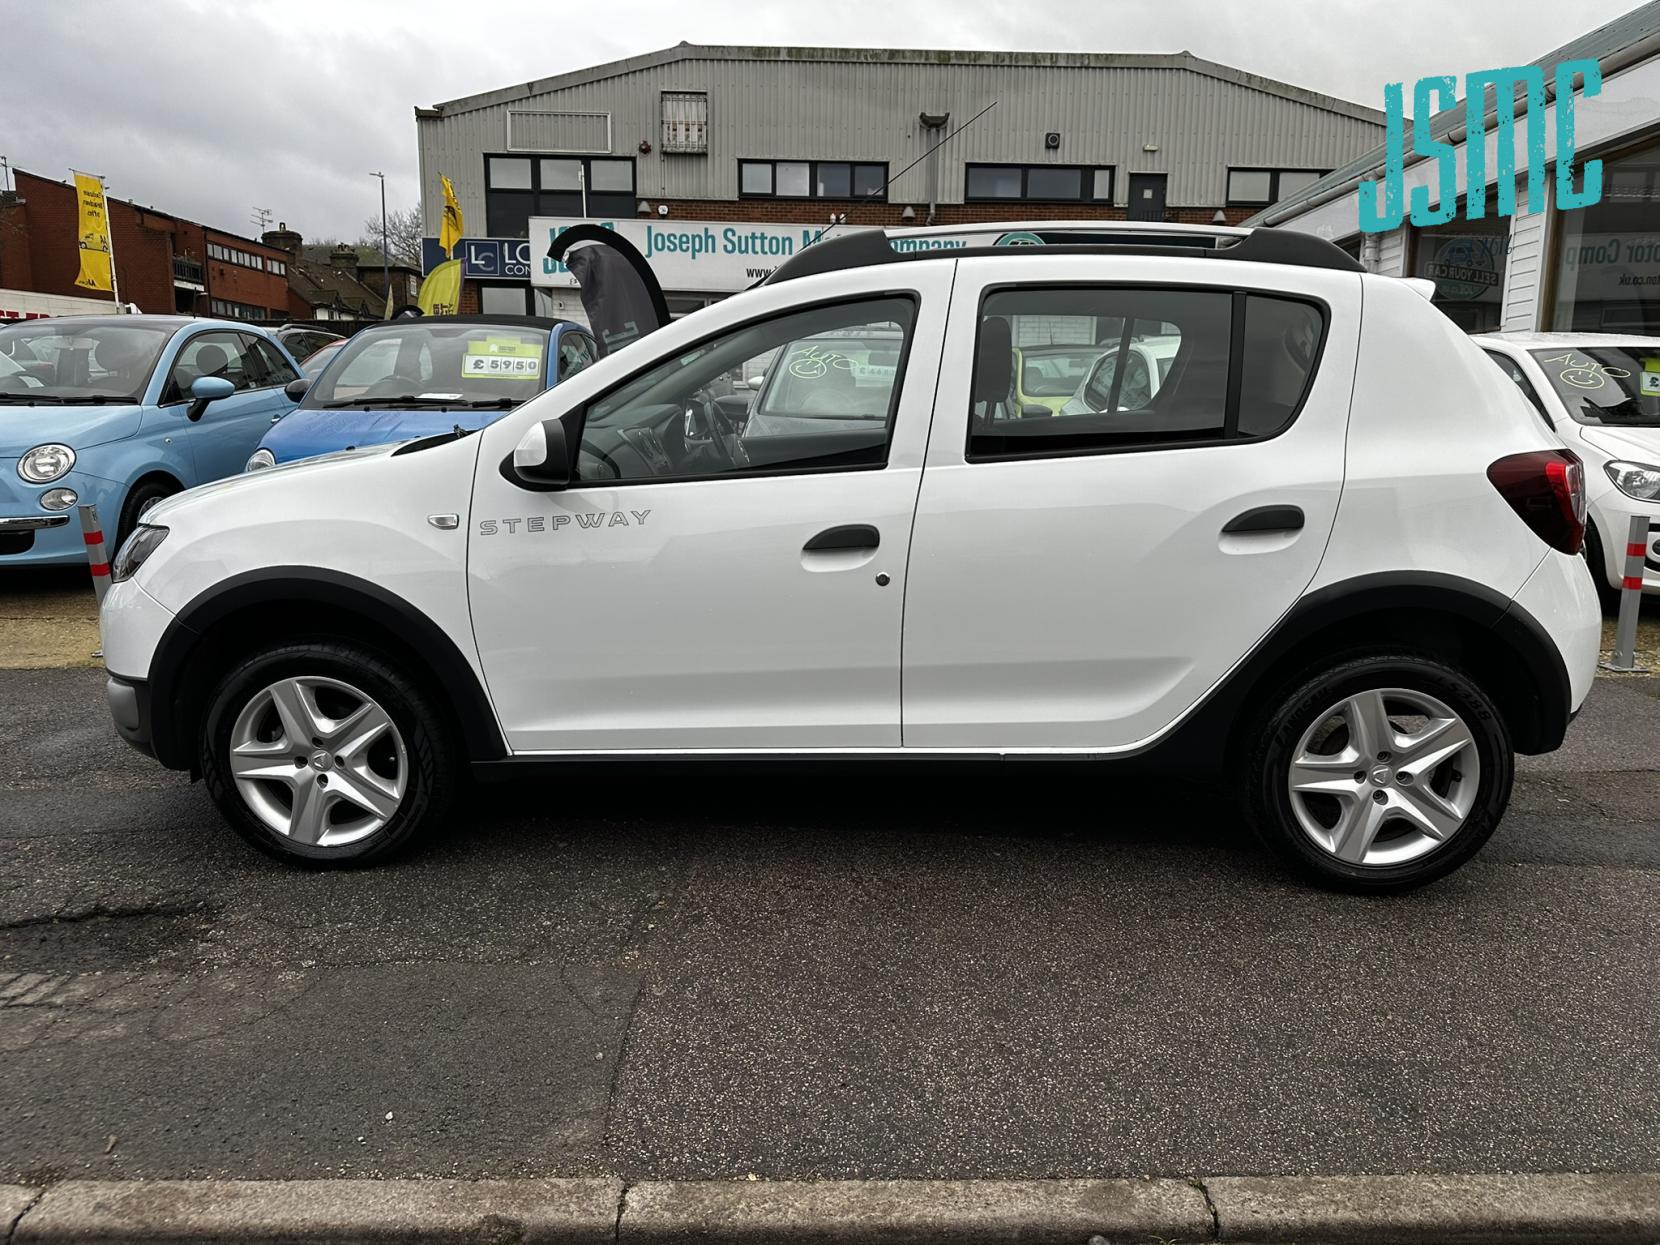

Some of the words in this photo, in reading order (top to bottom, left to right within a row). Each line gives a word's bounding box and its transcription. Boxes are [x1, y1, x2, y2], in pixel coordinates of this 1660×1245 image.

[645, 225, 717, 260] Joseph
[722, 227, 793, 256] Sutton
[791, 345, 859, 370] AUTO
[1544, 353, 1631, 378] AUTO
[479, 509, 652, 536] STEPWAY
